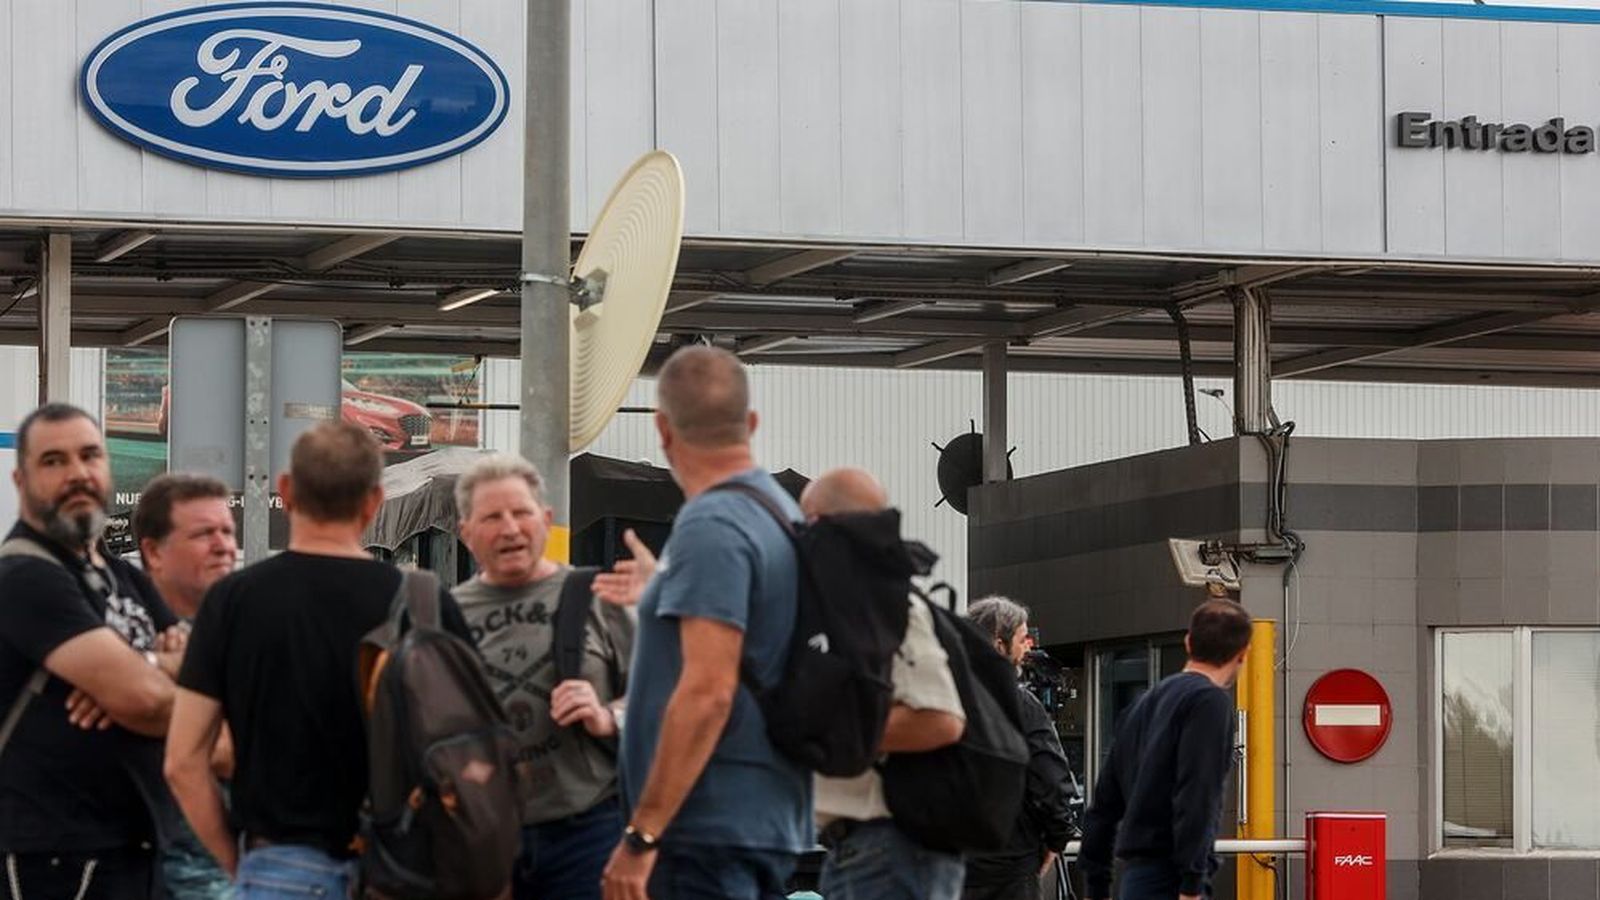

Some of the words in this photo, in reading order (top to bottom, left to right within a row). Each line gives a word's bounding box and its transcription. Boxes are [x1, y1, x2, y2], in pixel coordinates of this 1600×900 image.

[170, 29, 424, 137] Ford
[1397, 111, 1595, 154] Entrada
[1334, 854, 1374, 867] FAAC
